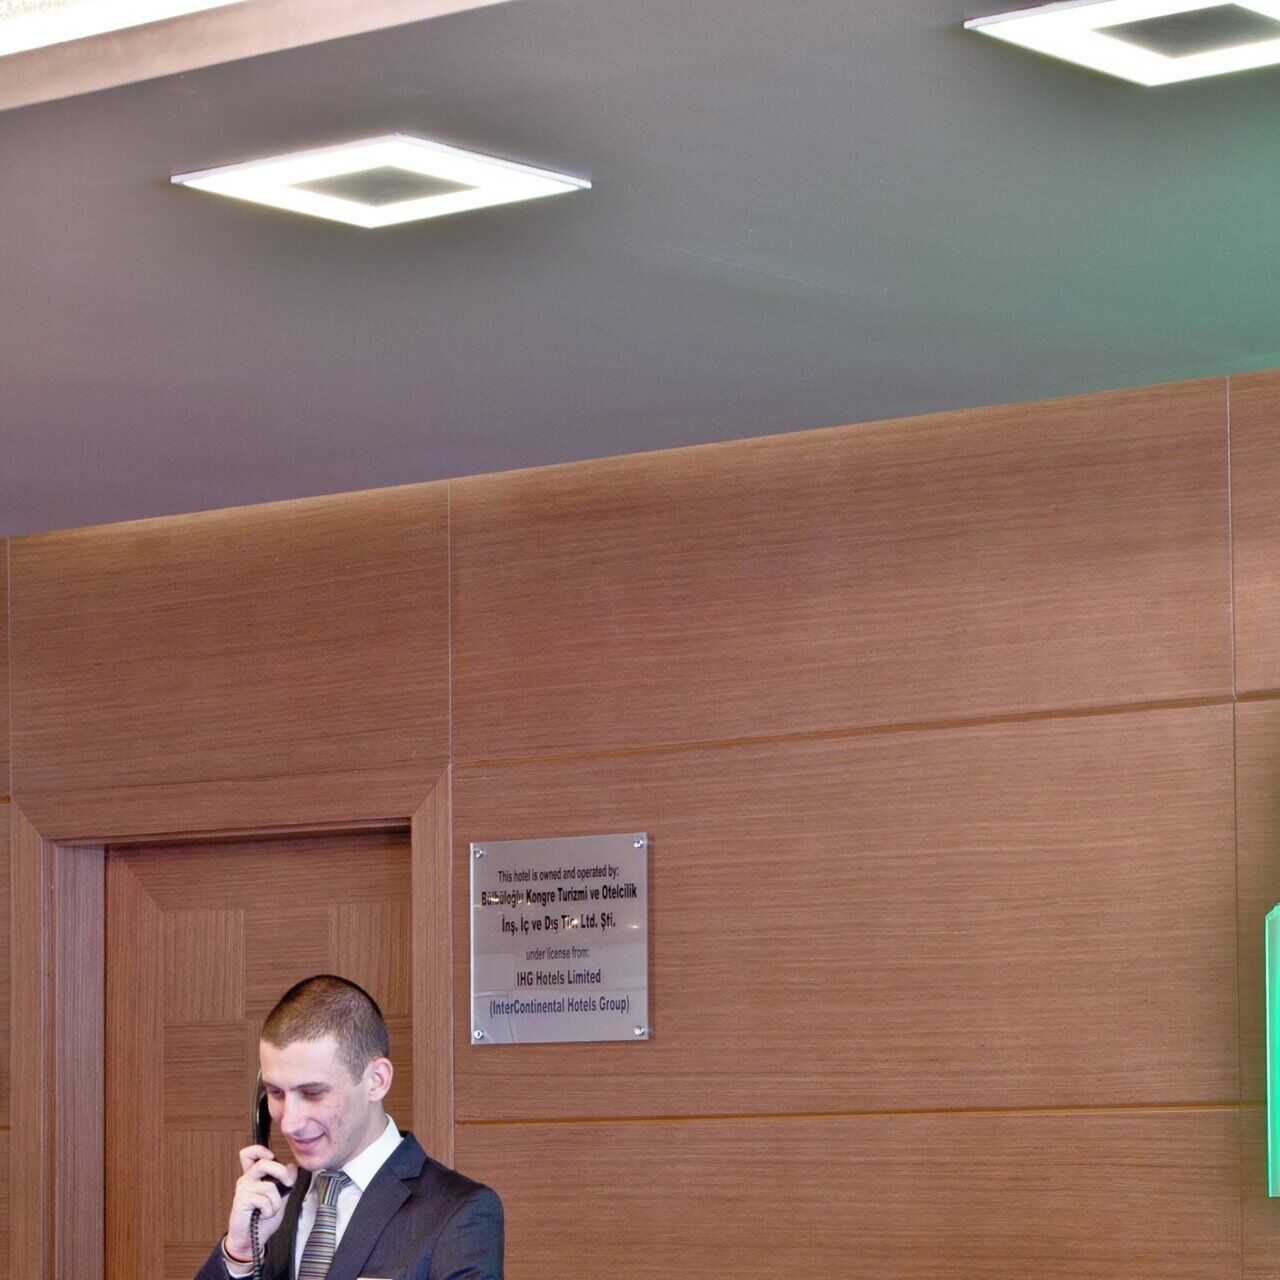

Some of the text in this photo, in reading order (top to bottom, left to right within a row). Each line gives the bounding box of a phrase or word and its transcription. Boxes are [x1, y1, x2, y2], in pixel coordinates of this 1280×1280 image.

[498, 864, 619, 883] This hotel is owned and operated by:
[526, 889, 556, 907] Kongre
[557, 886, 588, 902] Turizmi
[589, 888, 600, 900] ve
[601, 883, 638, 900] Otelcilik
[531, 919, 542, 931] ve
[580, 913, 598, 928] Ltd.
[525, 945, 590, 961] under license from:
[516, 968, 601, 987] IHG Hotels Limited
[489, 994, 630, 1019] (InterContinental Hotels Group)
